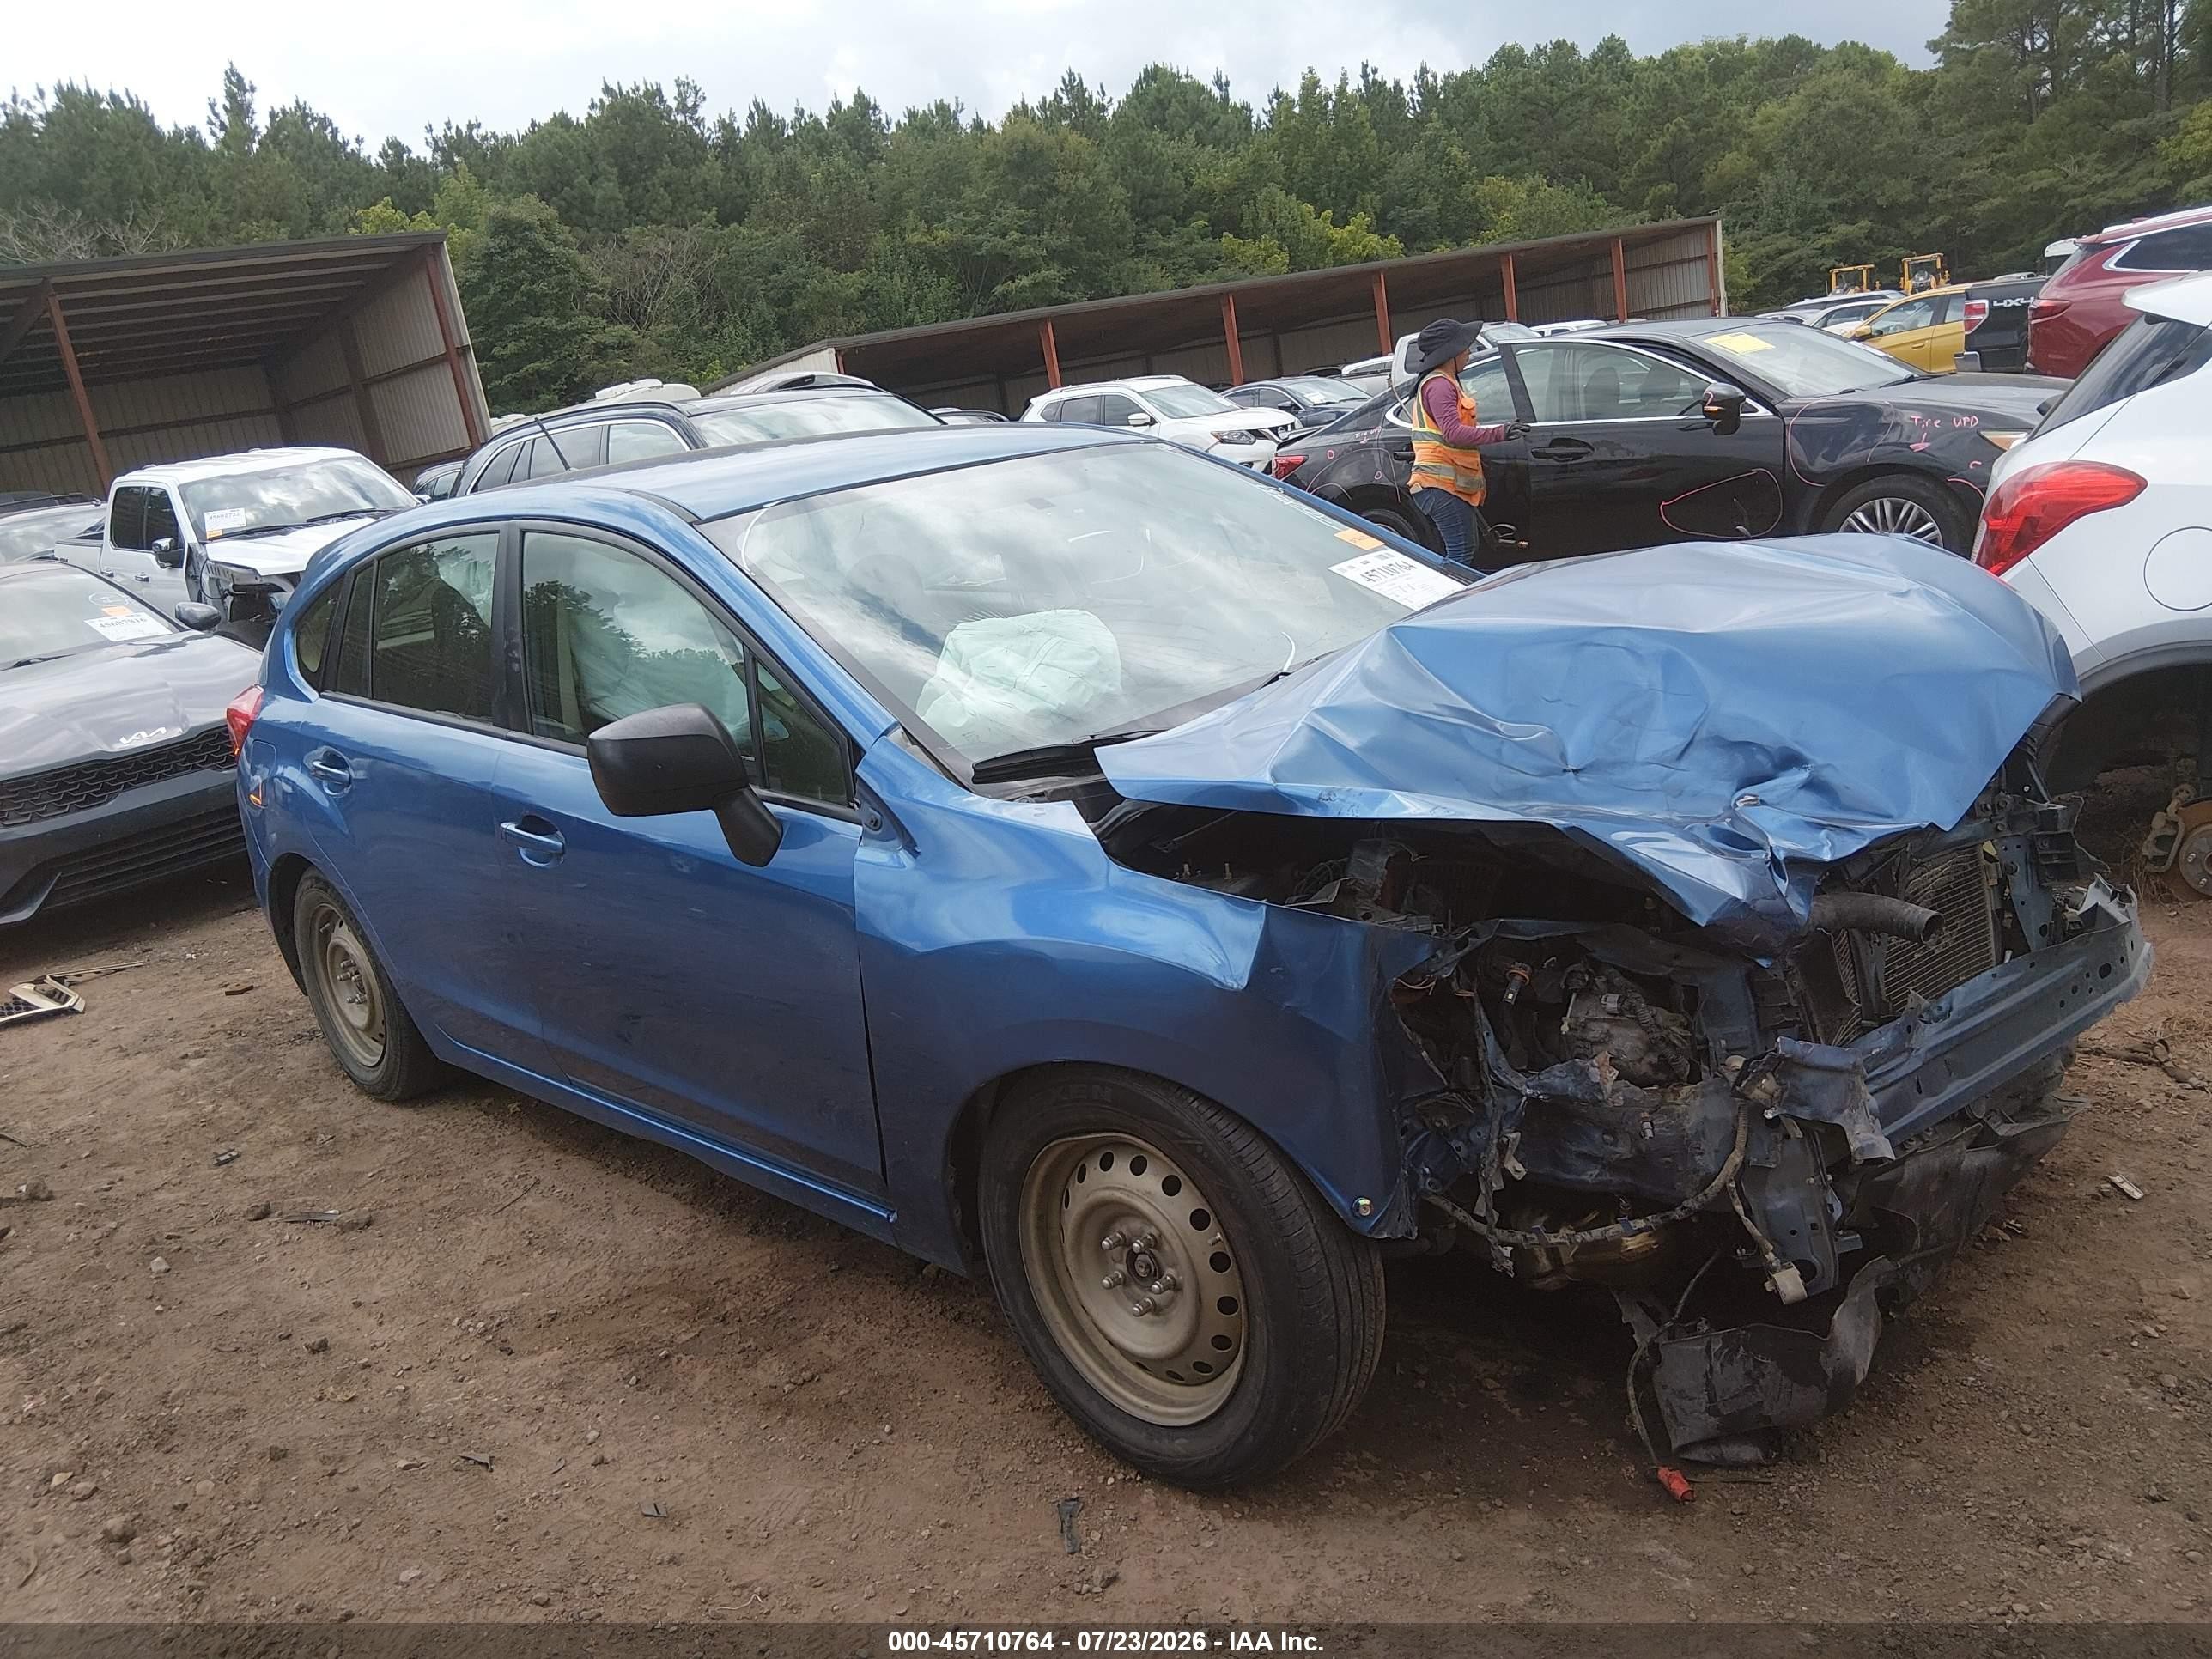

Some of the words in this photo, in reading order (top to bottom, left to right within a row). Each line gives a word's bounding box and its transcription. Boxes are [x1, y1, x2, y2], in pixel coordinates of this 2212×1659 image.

[1910, 416, 1942, 429] Tire
[1953, 415, 1979, 428] UPD
[1359, 560, 1417, 582] 45710764
